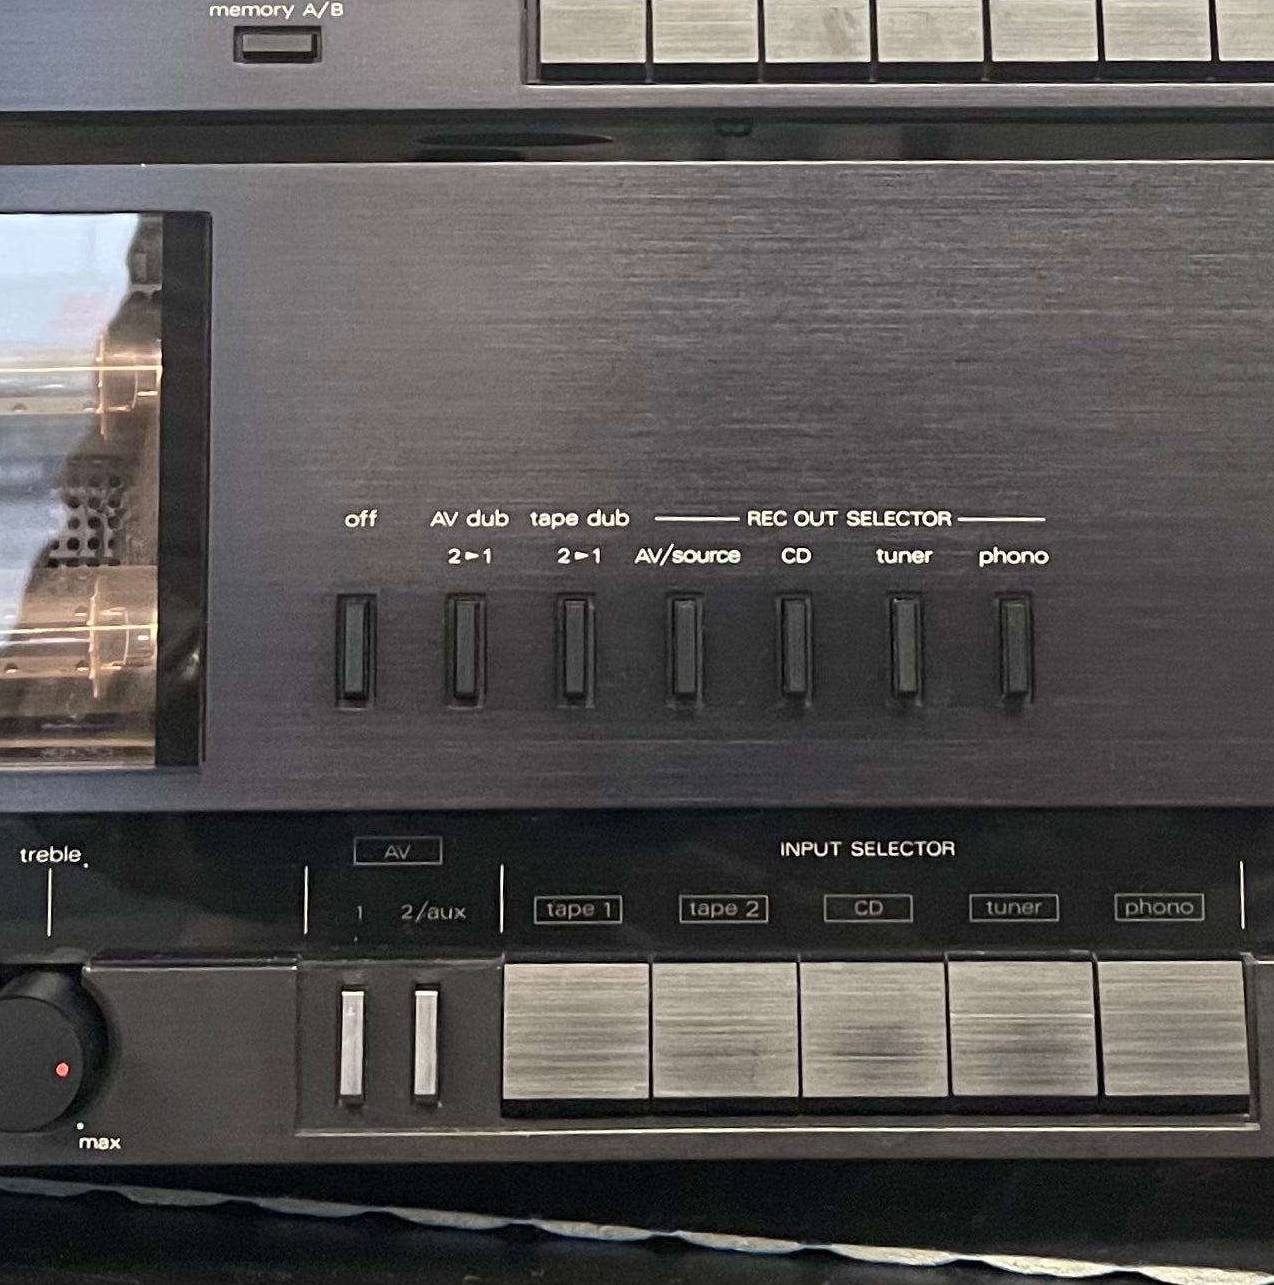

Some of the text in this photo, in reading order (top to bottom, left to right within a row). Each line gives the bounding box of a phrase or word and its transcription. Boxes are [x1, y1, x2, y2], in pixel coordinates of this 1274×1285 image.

[210, 1, 343, 19] memory A/B
[345, 510, 377, 527] off
[430, 509, 509, 527] AV dub
[530, 509, 629, 529] tape dub
[748, 510, 951, 527] REC OUT SELECTOR
[635, 544, 740, 566] AV/source
[782, 548, 811, 564] CD
[876, 549, 933, 564] tuner
[979, 547, 1049, 567] phono
[20, 846, 81, 862] treble
[385, 846, 410, 859] AV
[781, 841, 955, 856] INPUT SELECTOR
[357, 905, 363, 920] 1
[402, 901, 466, 922] 2/aux
[547, 901, 610, 919] tape 1
[692, 902, 758, 917] tape 2
[855, 901, 883, 915] CD
[987, 902, 1041, 914] tuner
[1126, 900, 1193, 915] phono
[80, 1138, 121, 1150] max
